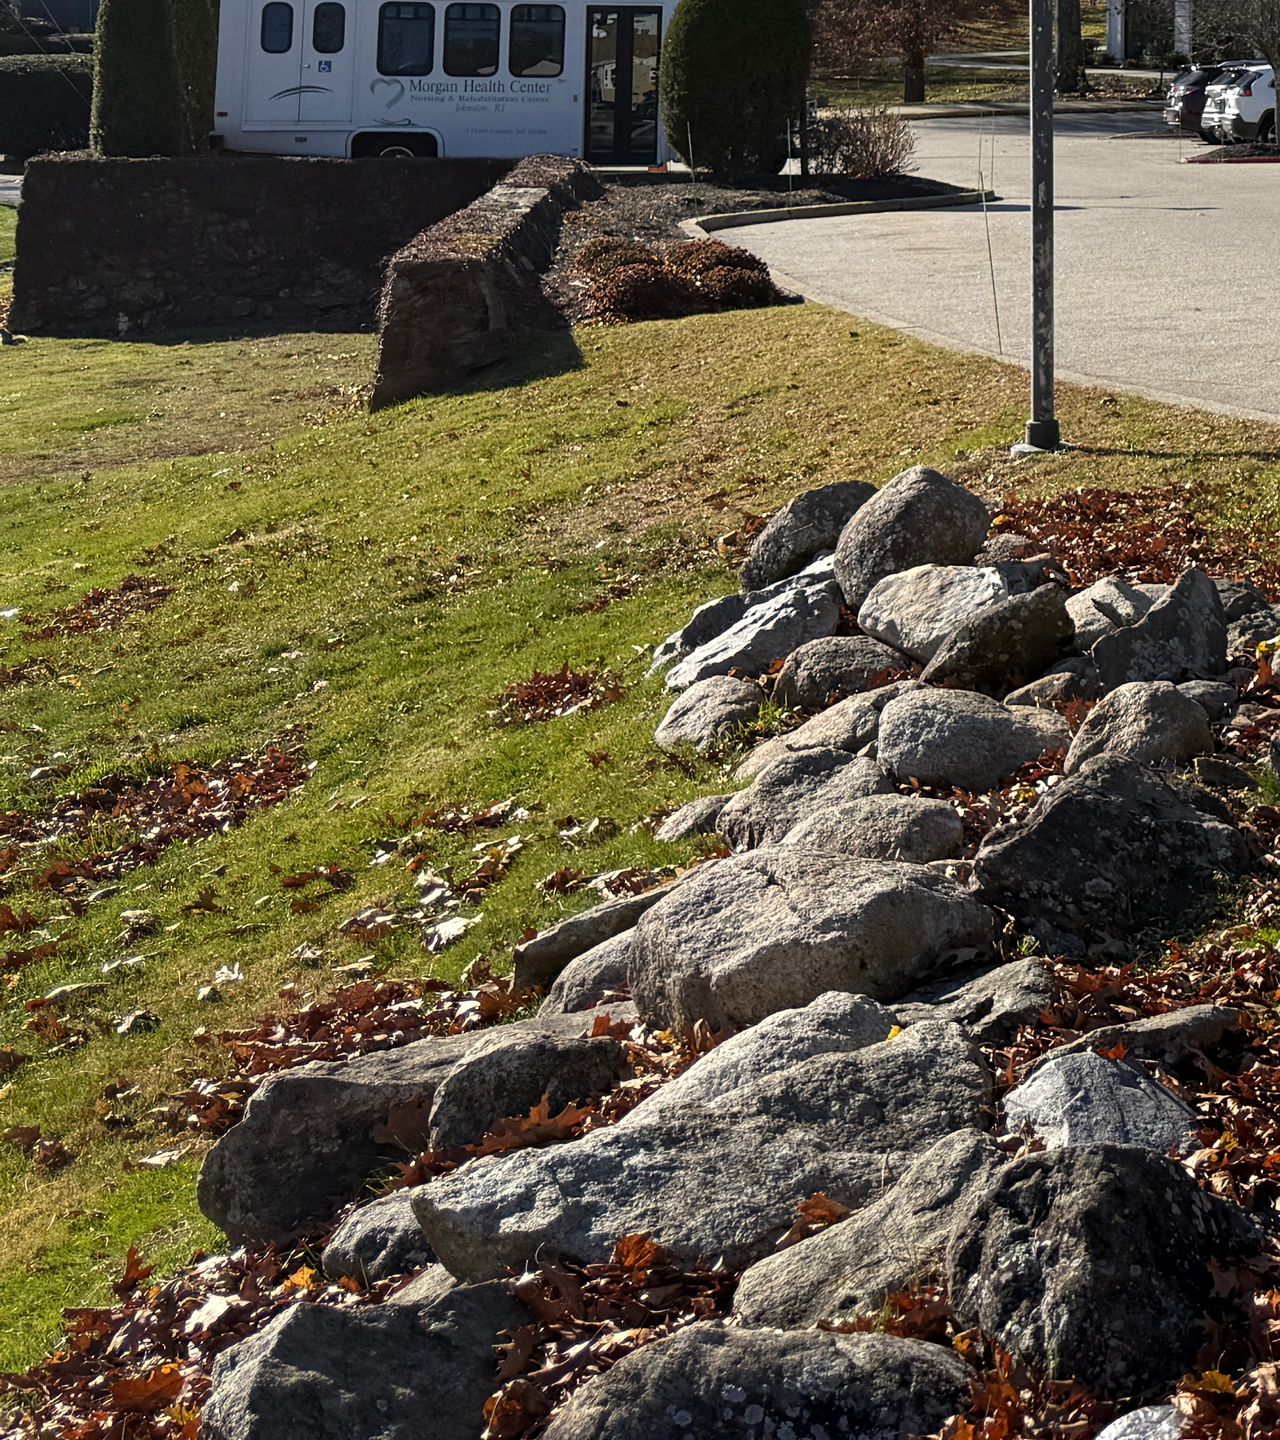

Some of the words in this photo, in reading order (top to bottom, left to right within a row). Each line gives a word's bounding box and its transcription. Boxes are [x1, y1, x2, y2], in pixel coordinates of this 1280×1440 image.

[409, 79, 458, 95] Morgan
[464, 79, 505, 93] Health
[510, 79, 552, 93] Center
